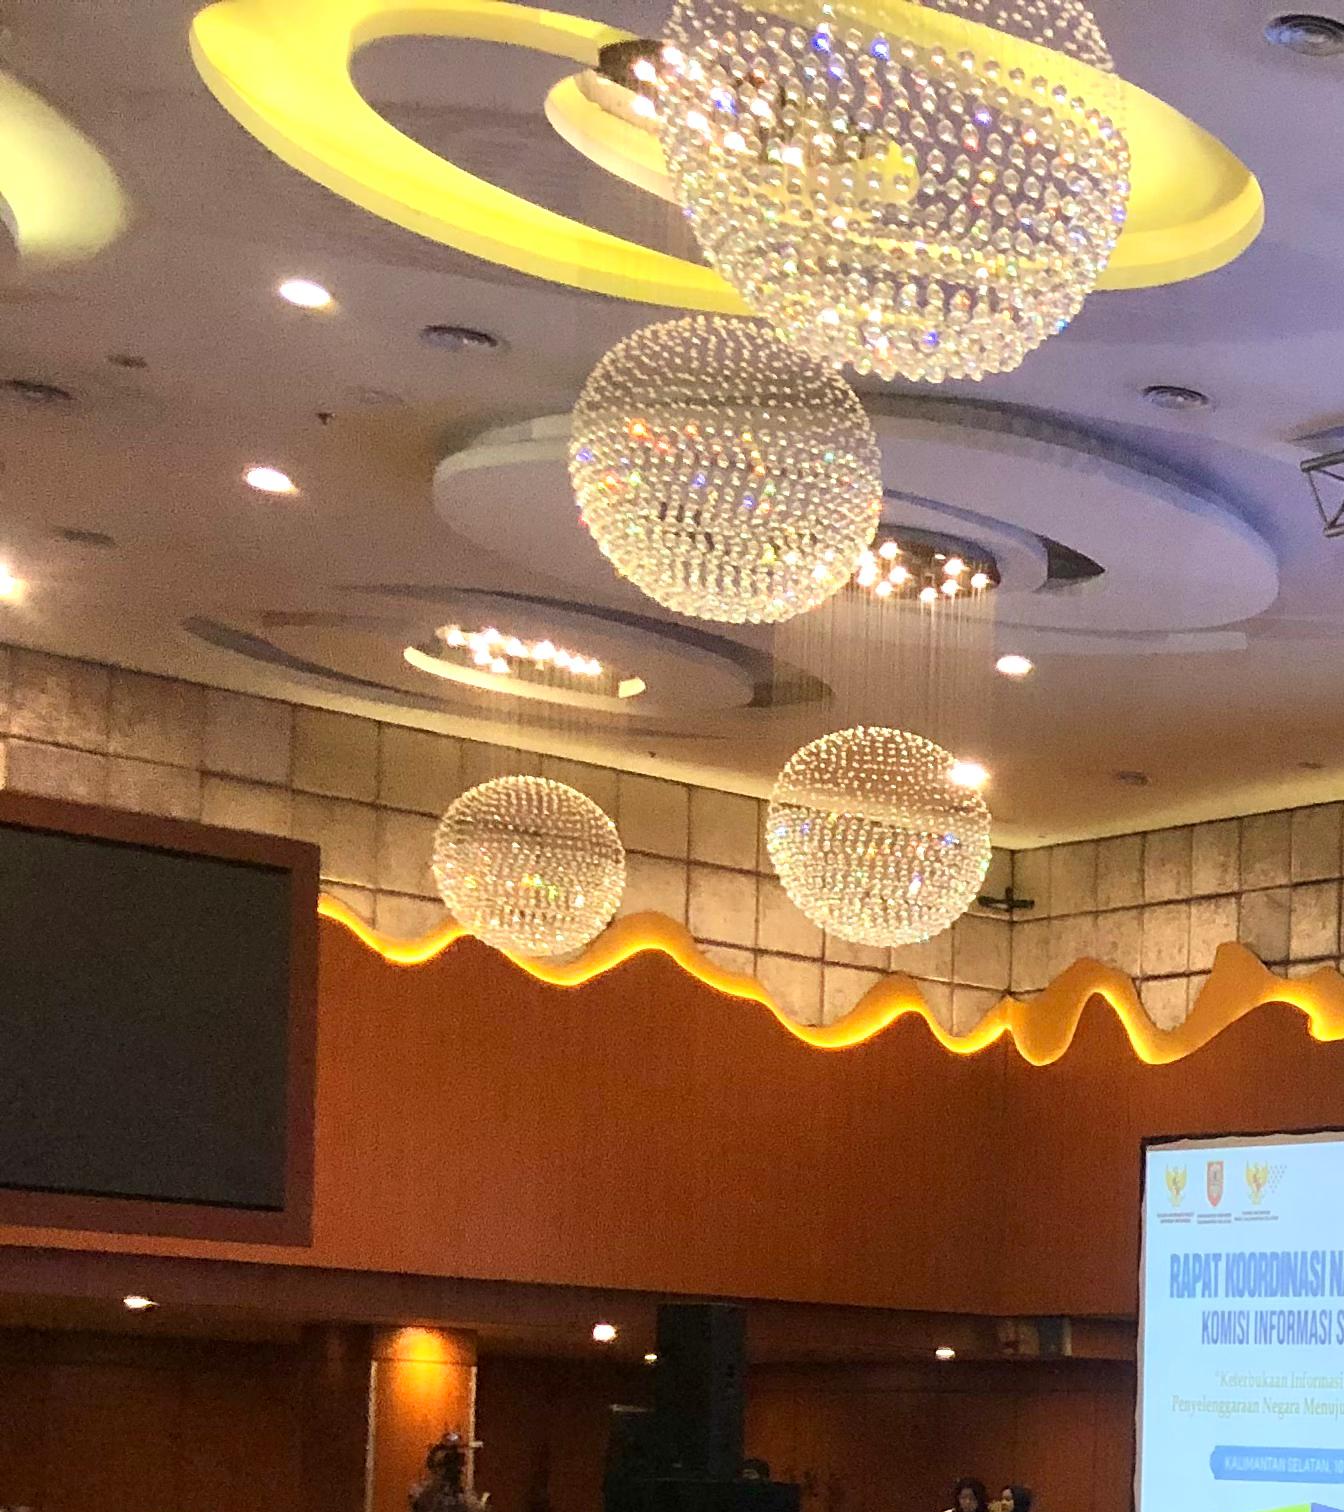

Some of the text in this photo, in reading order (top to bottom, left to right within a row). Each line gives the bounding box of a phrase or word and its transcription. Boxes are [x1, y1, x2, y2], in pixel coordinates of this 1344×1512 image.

[1170, 1253, 1222, 1298] RAPAT
[1225, 1250, 1326, 1298] KOORDINASI
[1201, 1310, 1250, 1345] KOMISI
[1254, 1309, 1332, 1345] INFORMASI
